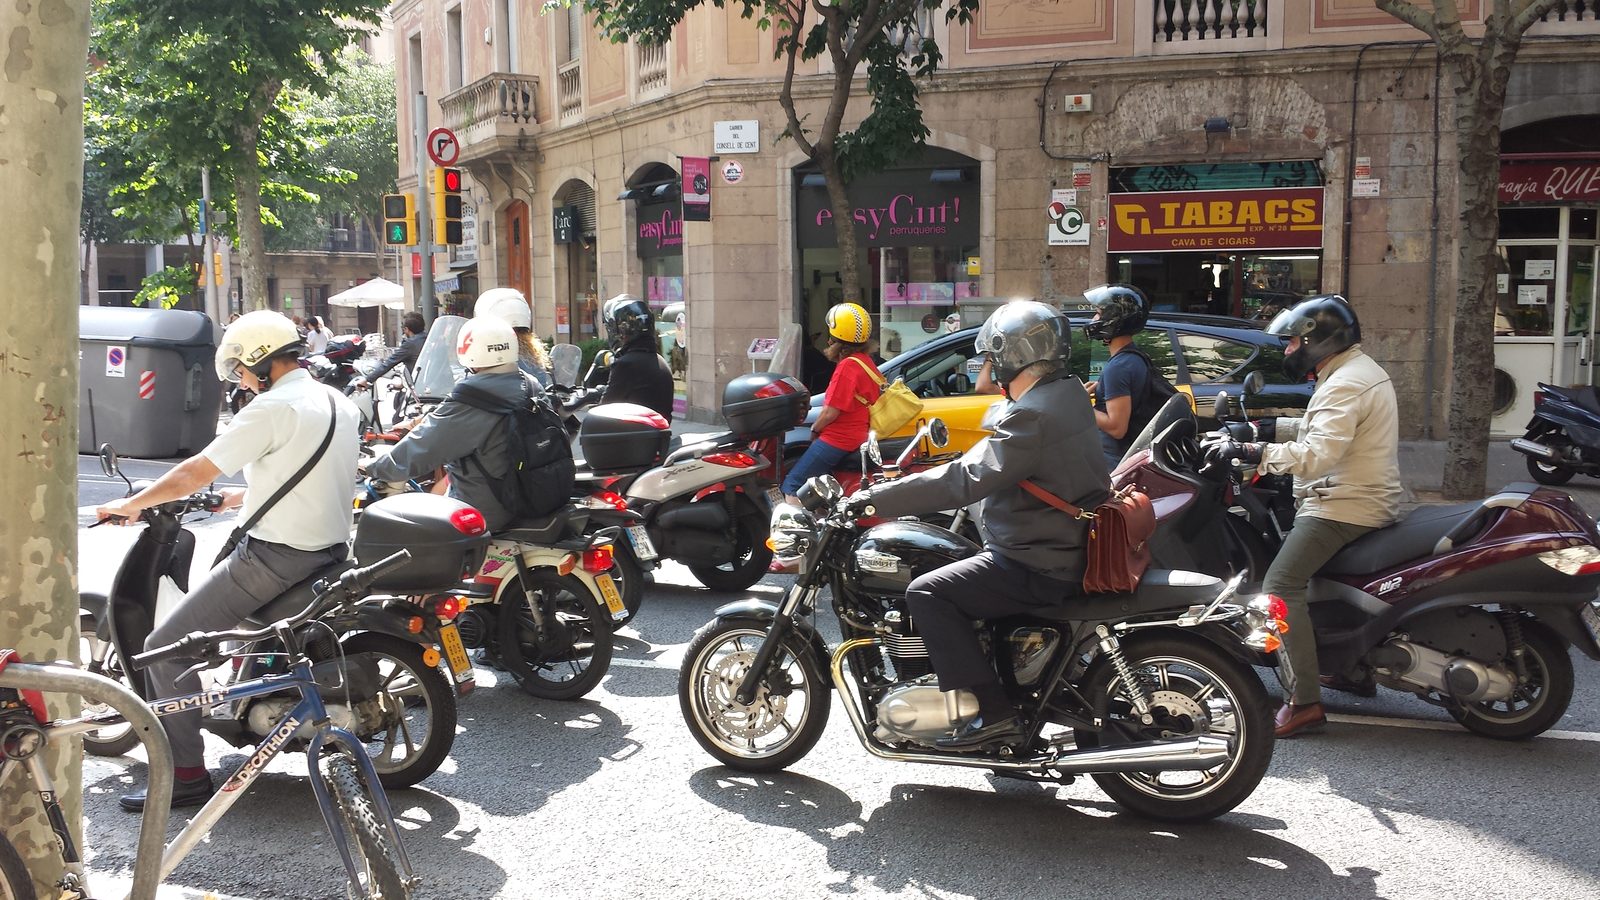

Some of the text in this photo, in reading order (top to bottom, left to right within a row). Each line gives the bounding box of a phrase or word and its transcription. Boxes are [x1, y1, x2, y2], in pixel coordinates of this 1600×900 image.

[816, 194, 960, 239] esyCut!
[1160, 198, 1316, 227] TABACS
[1171, 237, 1256, 247] CAVA DE CIGARS
[237, 716, 301, 781] DECATHLON
